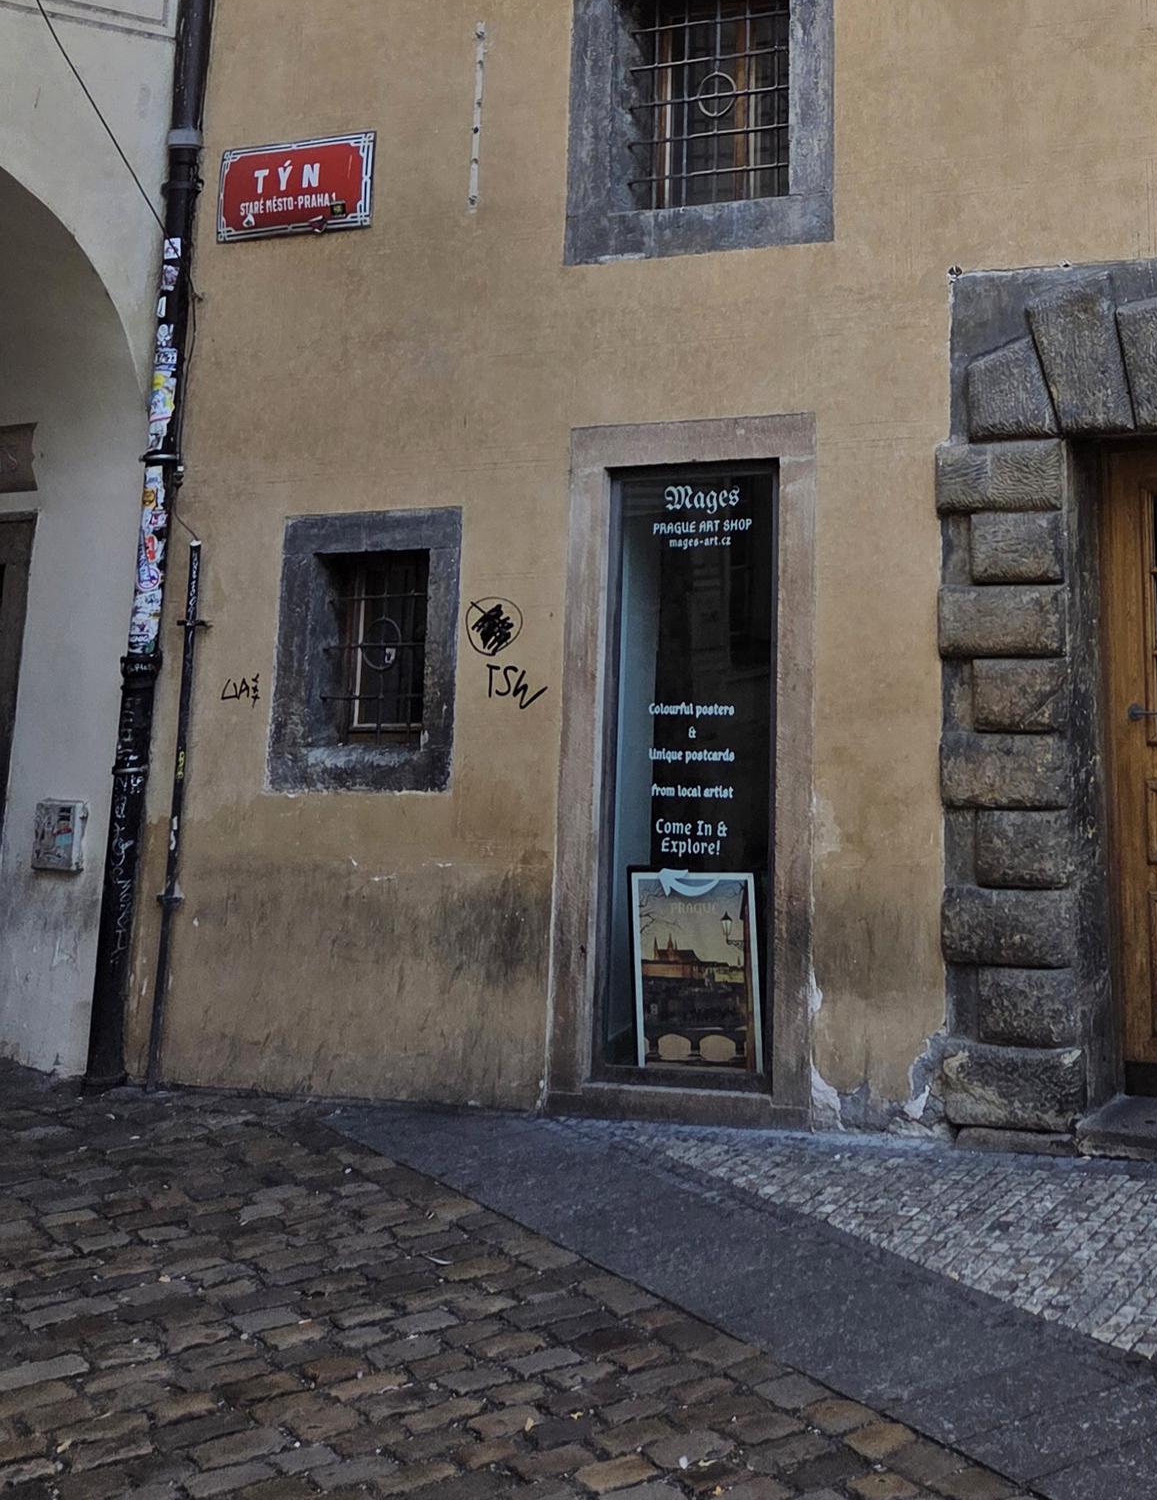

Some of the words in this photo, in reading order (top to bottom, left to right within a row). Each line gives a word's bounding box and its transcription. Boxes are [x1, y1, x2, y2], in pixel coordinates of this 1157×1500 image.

[254, 159, 320, 194] TÝN
[299, 193, 330, 209] PRAHA
[664, 484, 740, 514] Mages
[653, 521, 696, 535] PRAGUE
[699, 520, 720, 533] ART
[723, 518, 752, 532] SHOP
[669, 536, 731, 550] mages-art.cz
[649, 703, 694, 716] Colourful
[695, 704, 735, 718] posters
[688, 726, 697, 739] &
[649, 748, 683, 763] Unique
[685, 748, 735, 764] postcards
[651, 783, 675, 797] from
[677, 784, 701, 797] local
[703, 785, 734, 798] artist
[655, 818, 692, 835] Come
[696, 820, 712, 836] In
[717, 821, 728, 836] &
[661, 837, 720, 857] Explore!
